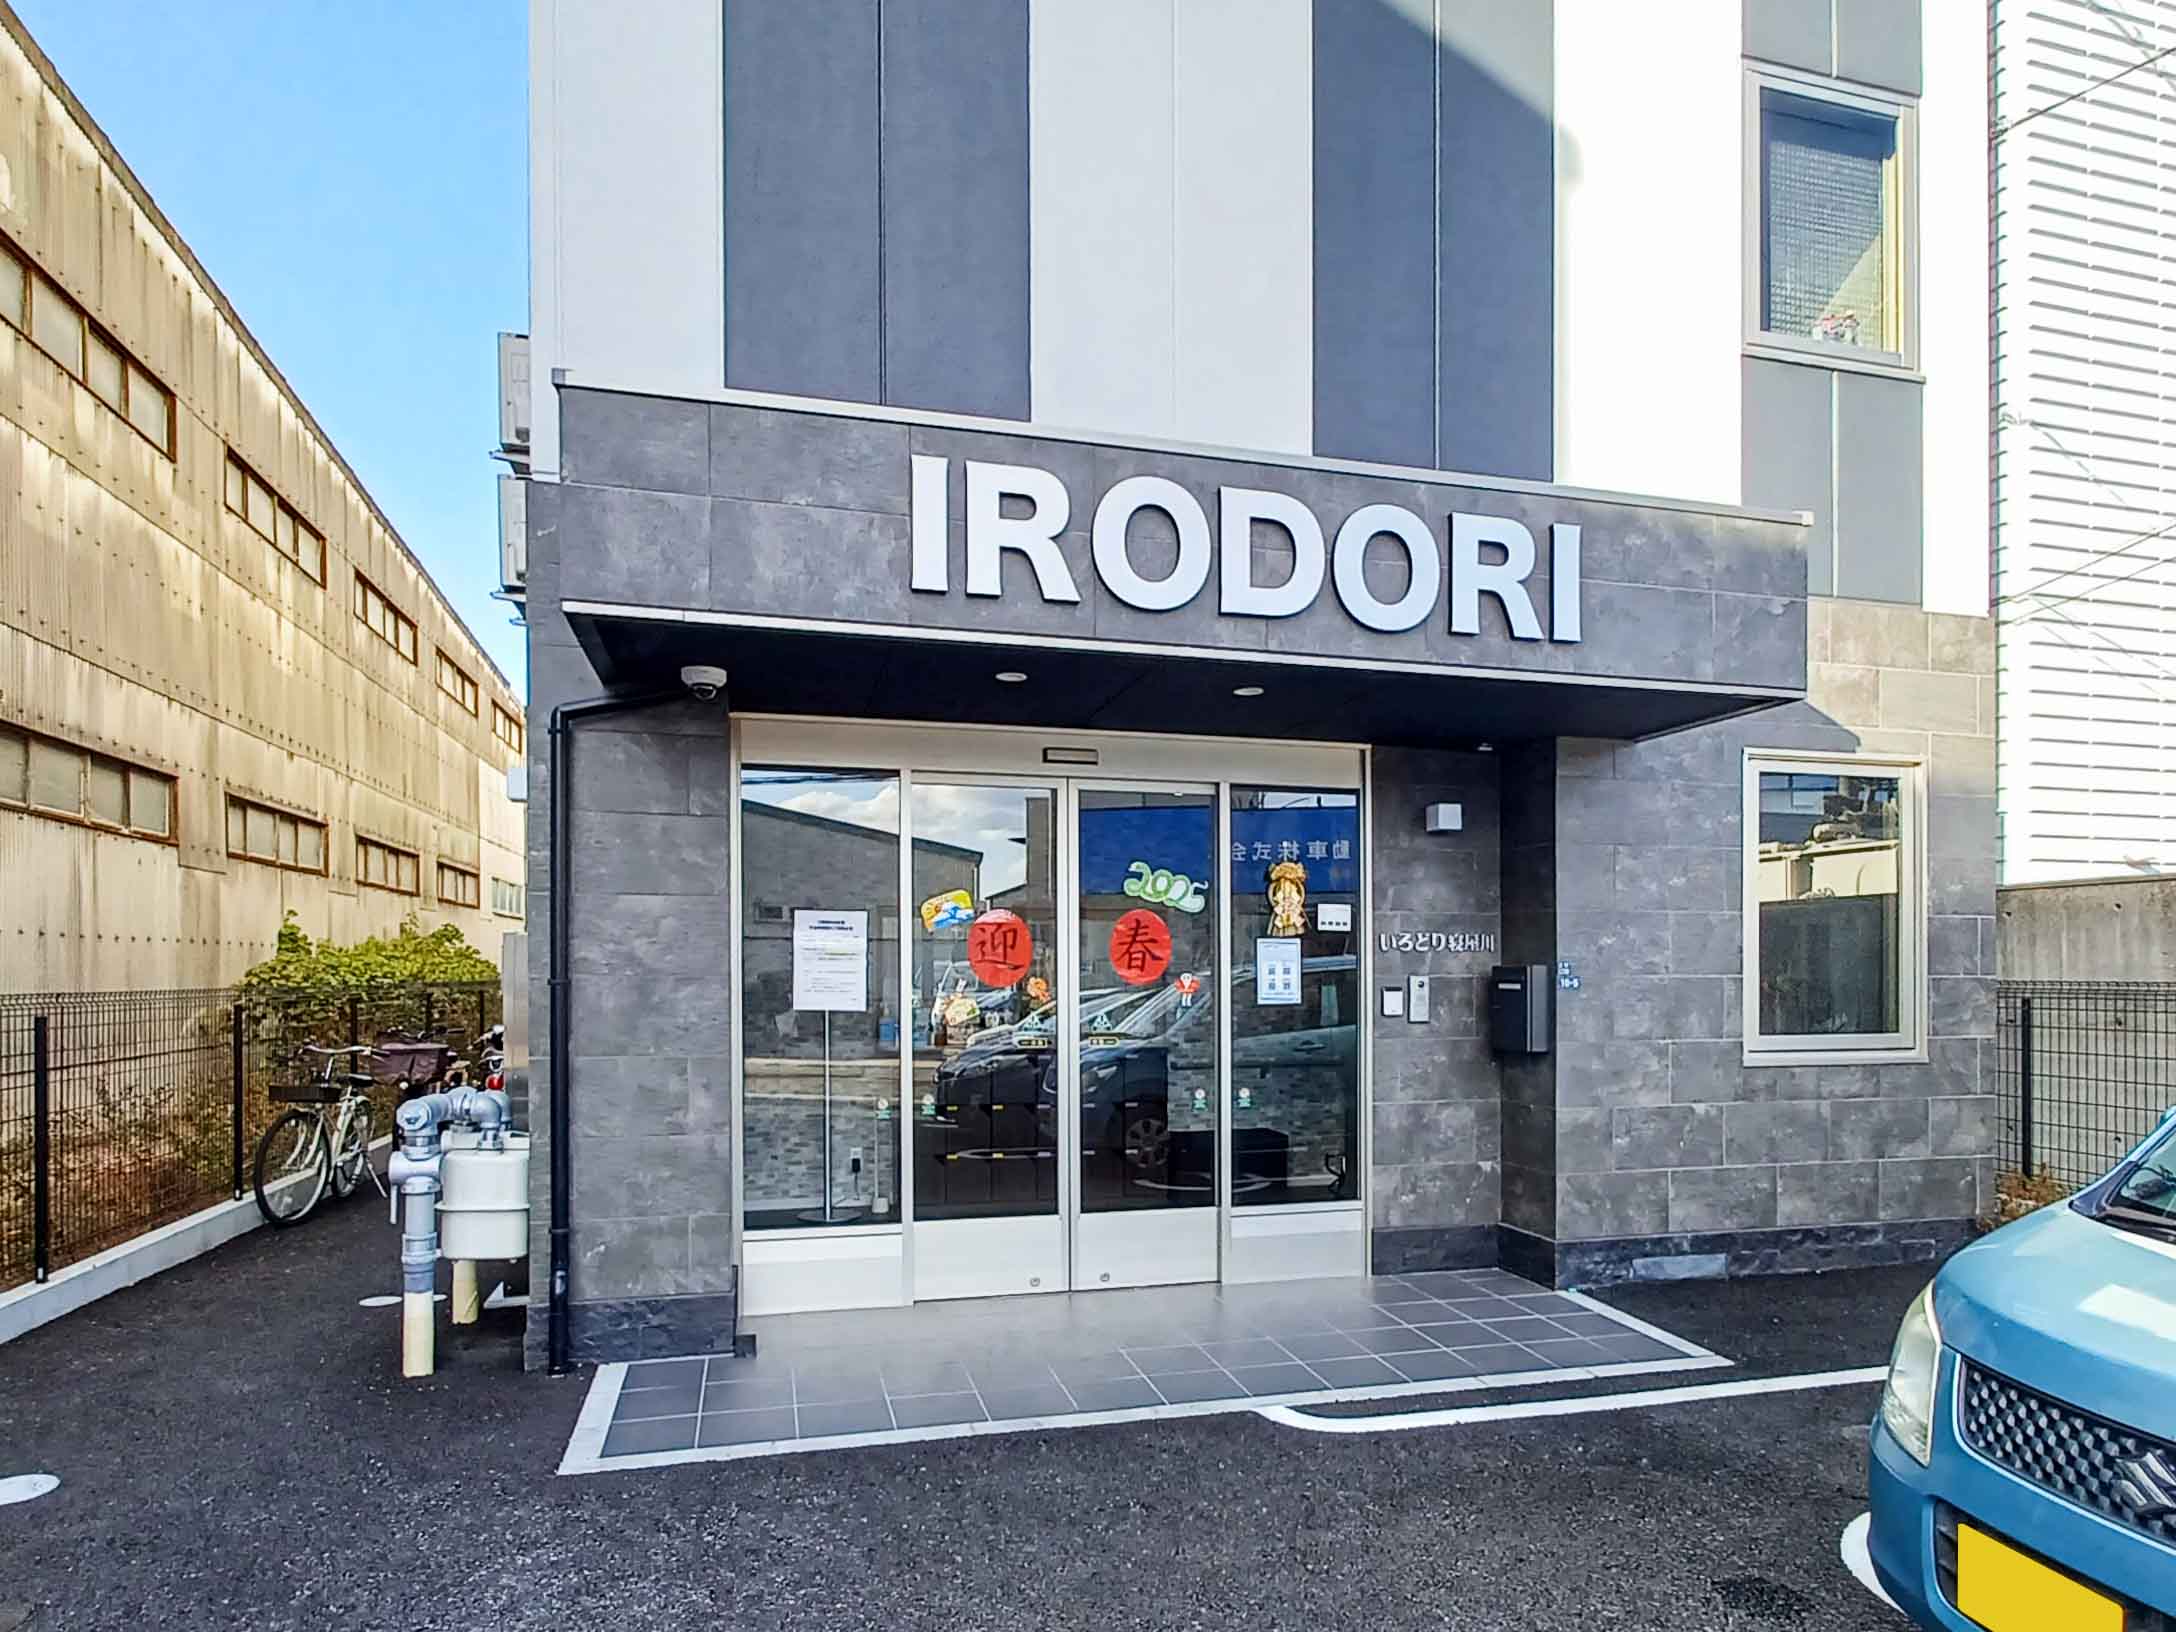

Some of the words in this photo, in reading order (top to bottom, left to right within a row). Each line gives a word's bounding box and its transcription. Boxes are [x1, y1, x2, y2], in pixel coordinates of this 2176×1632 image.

[911, 455, 1582, 644] IRODORI
[1123, 861, 1208, 913] 2025
[974, 922, 1025, 970] 迎
[1115, 917, 1164, 972] 春
